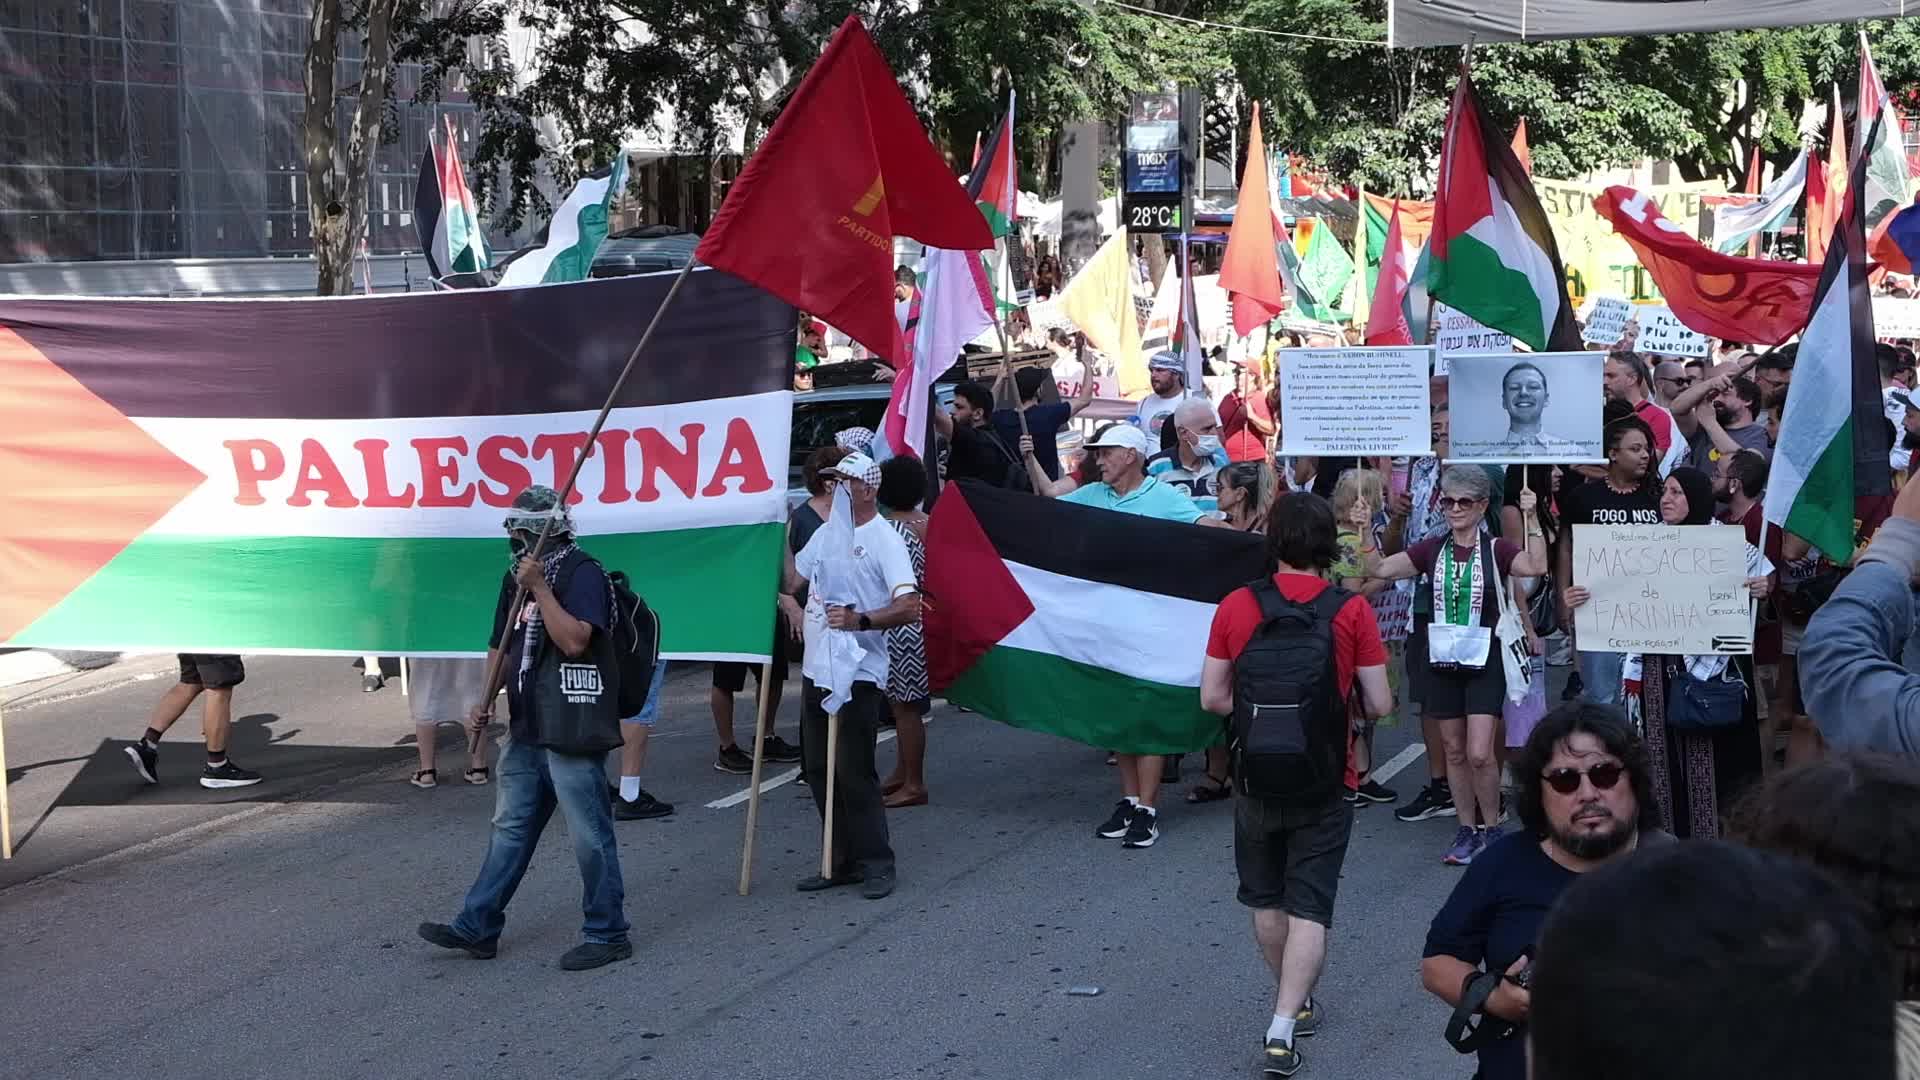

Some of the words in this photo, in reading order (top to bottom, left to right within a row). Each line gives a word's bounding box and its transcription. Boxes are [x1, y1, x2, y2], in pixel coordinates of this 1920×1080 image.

[1137, 152, 1168, 166] max
[1132, 206, 1170, 227] 28°C
[838, 216, 889, 251] PARTIDO
[223, 417, 774, 508] PALESTINA
[1592, 508, 1627, 523] FOGO
[1632, 508, 1658, 524] NOS
[1586, 546, 1729, 578] MASSACRE
[1594, 600, 1702, 633] FARINHA
[566, 668, 597, 690] PUBG
[567, 695, 597, 704] MOBILE
